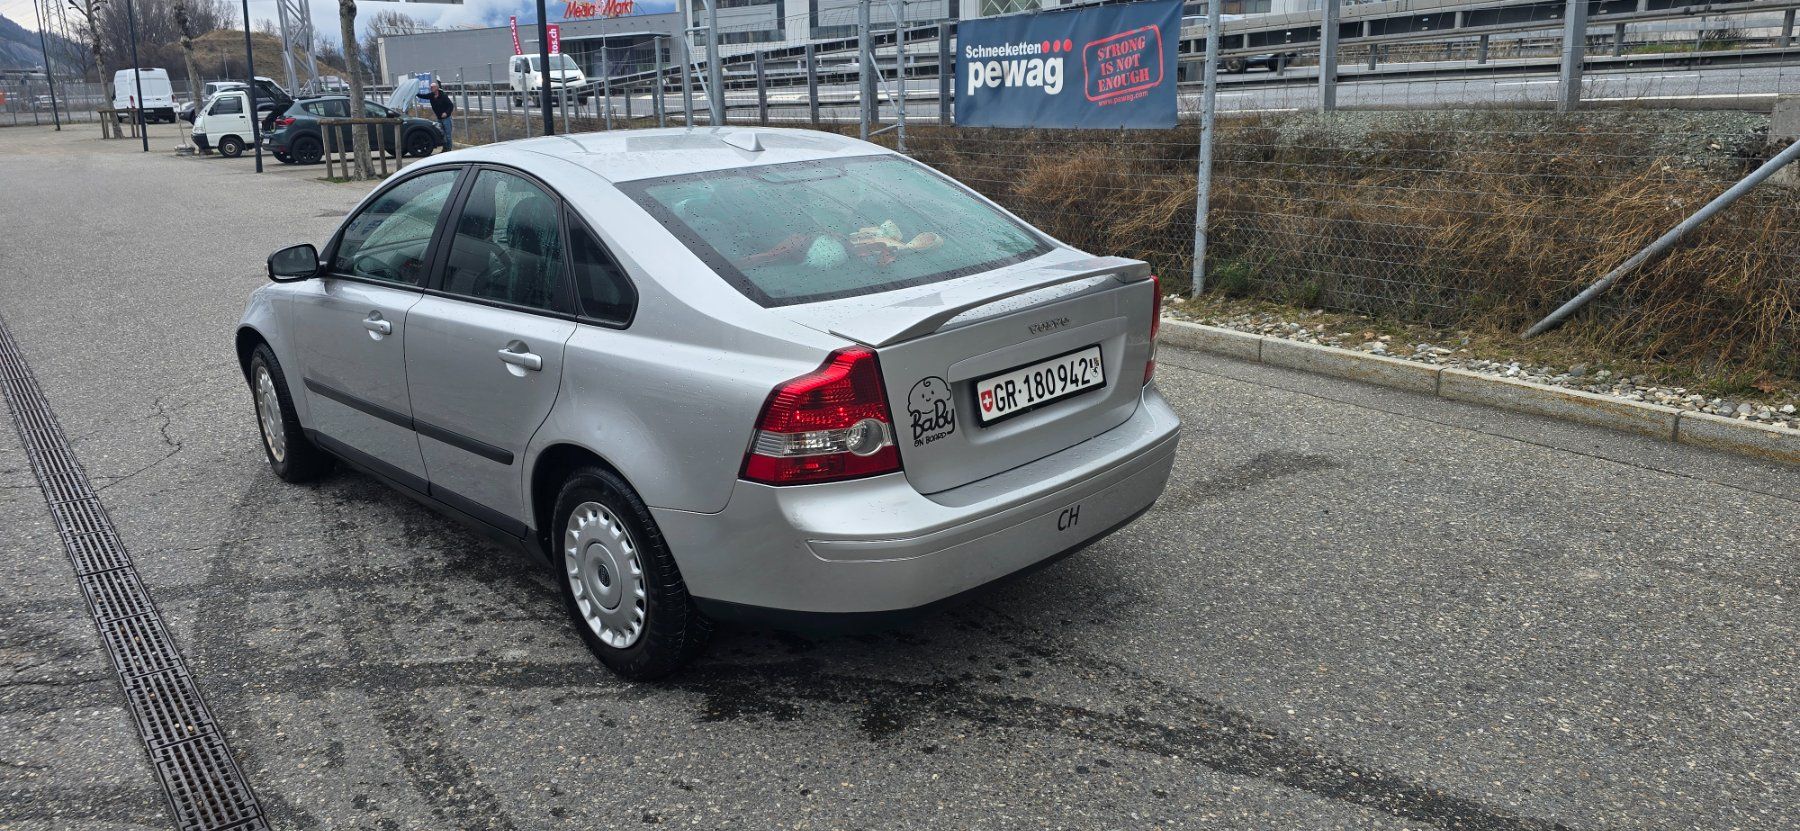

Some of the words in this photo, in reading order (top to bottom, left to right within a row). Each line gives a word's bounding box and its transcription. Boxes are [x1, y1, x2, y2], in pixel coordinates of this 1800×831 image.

[564, 1, 596, 19] Media
[602, 0, 634, 17] Markt
[965, 41, 1041, 58] Schneeketten
[1097, 35, 1146, 61] STRONG
[1101, 61, 1114, 75] IS
[1116, 53, 1141, 71] NOT
[967, 57, 1064, 96] pewag
[1097, 67, 1150, 93] ENOUGH
[914, 438, 924, 447] ON
[925, 431, 947, 444] BOARD
[1058, 504, 1081, 531] CH
